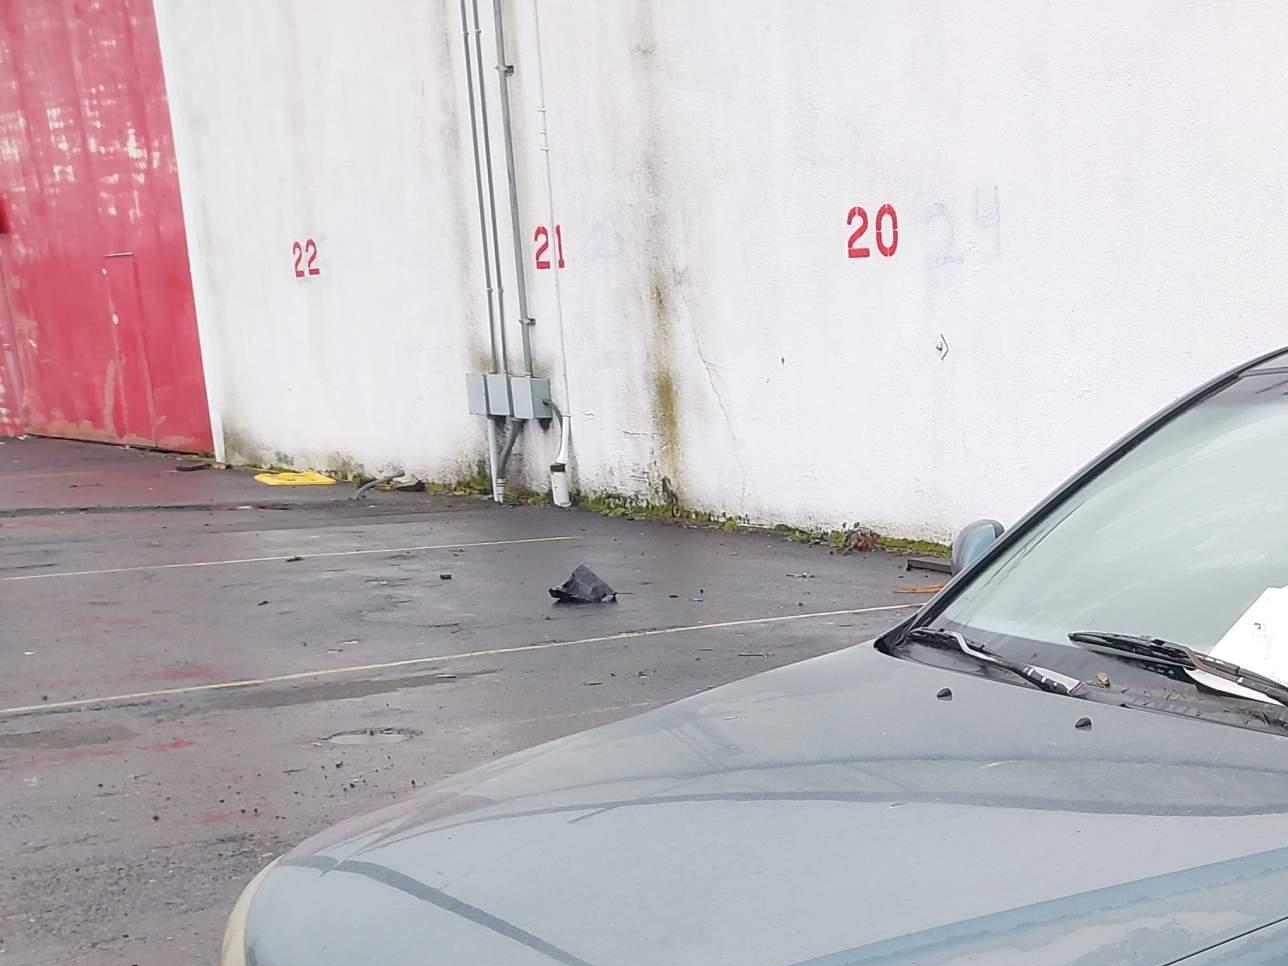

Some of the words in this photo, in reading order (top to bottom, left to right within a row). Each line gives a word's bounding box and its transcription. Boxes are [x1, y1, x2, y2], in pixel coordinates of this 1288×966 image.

[534, 225, 565, 270] 21
[847, 203, 899, 259] 20
[292, 239, 320, 277] 22
